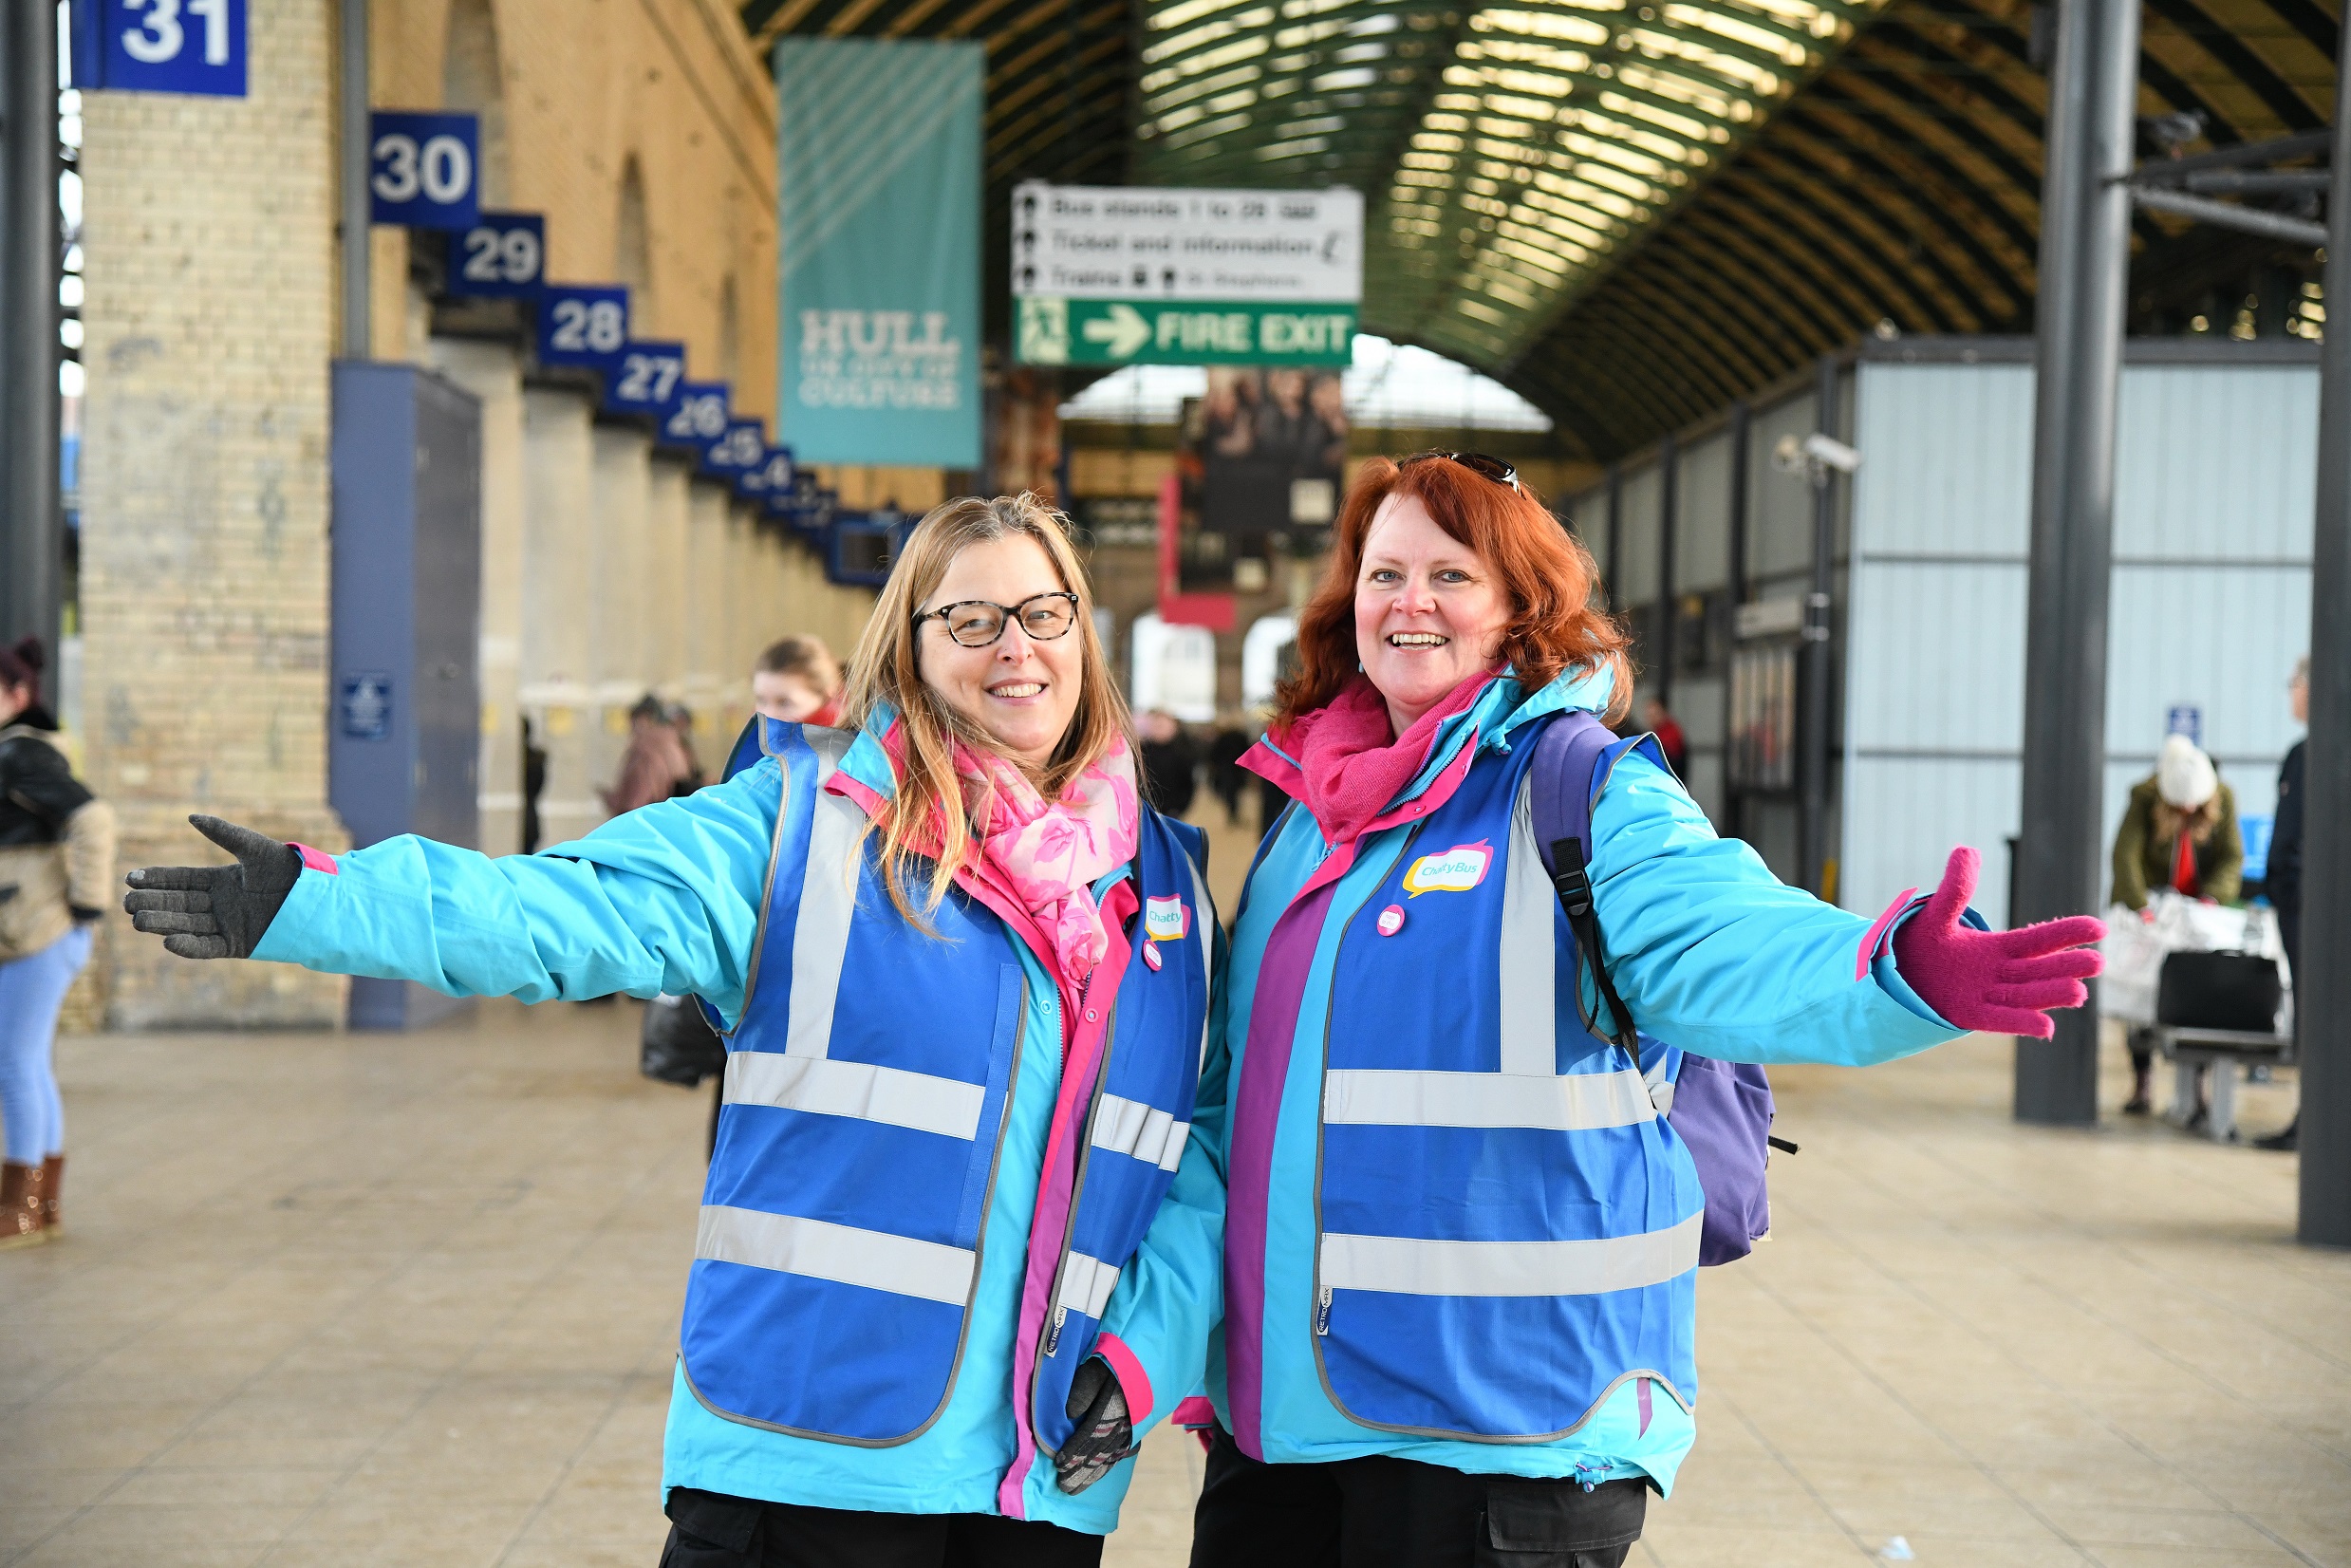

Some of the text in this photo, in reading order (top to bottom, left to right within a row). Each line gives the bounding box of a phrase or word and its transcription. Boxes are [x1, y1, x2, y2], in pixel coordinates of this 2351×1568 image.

[121, 0, 230, 65] 31
[372, 135, 473, 205] 30
[464, 227, 540, 284] 29
[551, 300, 624, 351] 28
[802, 310, 959, 355] HULL
[1156, 312, 1353, 353] FIRE EXIT
[619, 355, 681, 402] 27
[799, 378, 959, 409] CULTURE
[667, 394, 726, 437] 26
[1048, 1328, 1060, 1353] RETRO
[1318, 1307, 1328, 1332] RETRO
